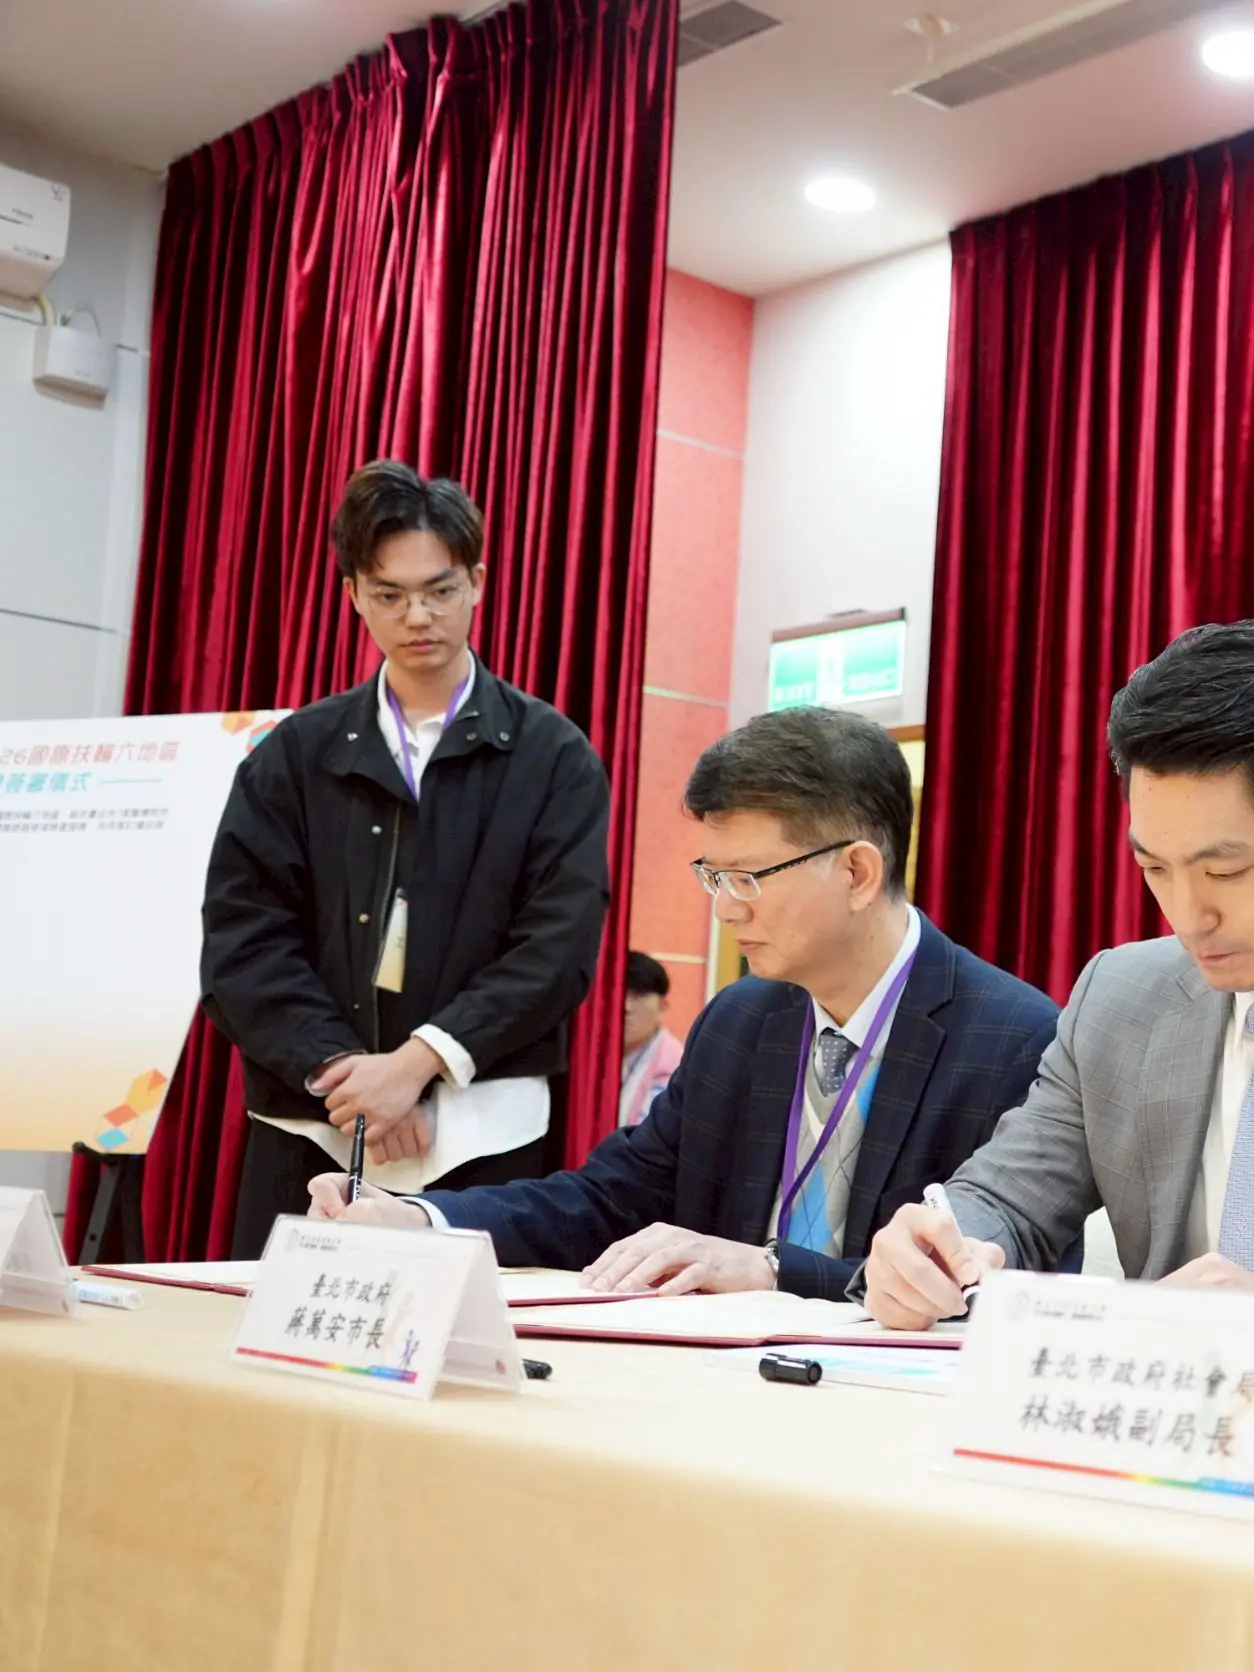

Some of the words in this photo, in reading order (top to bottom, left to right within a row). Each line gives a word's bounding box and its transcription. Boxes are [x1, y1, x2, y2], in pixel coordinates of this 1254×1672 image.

[309, 1271, 392, 1308] 臺北市政府
[284, 1304, 386, 1350] 蔣萬安市長
